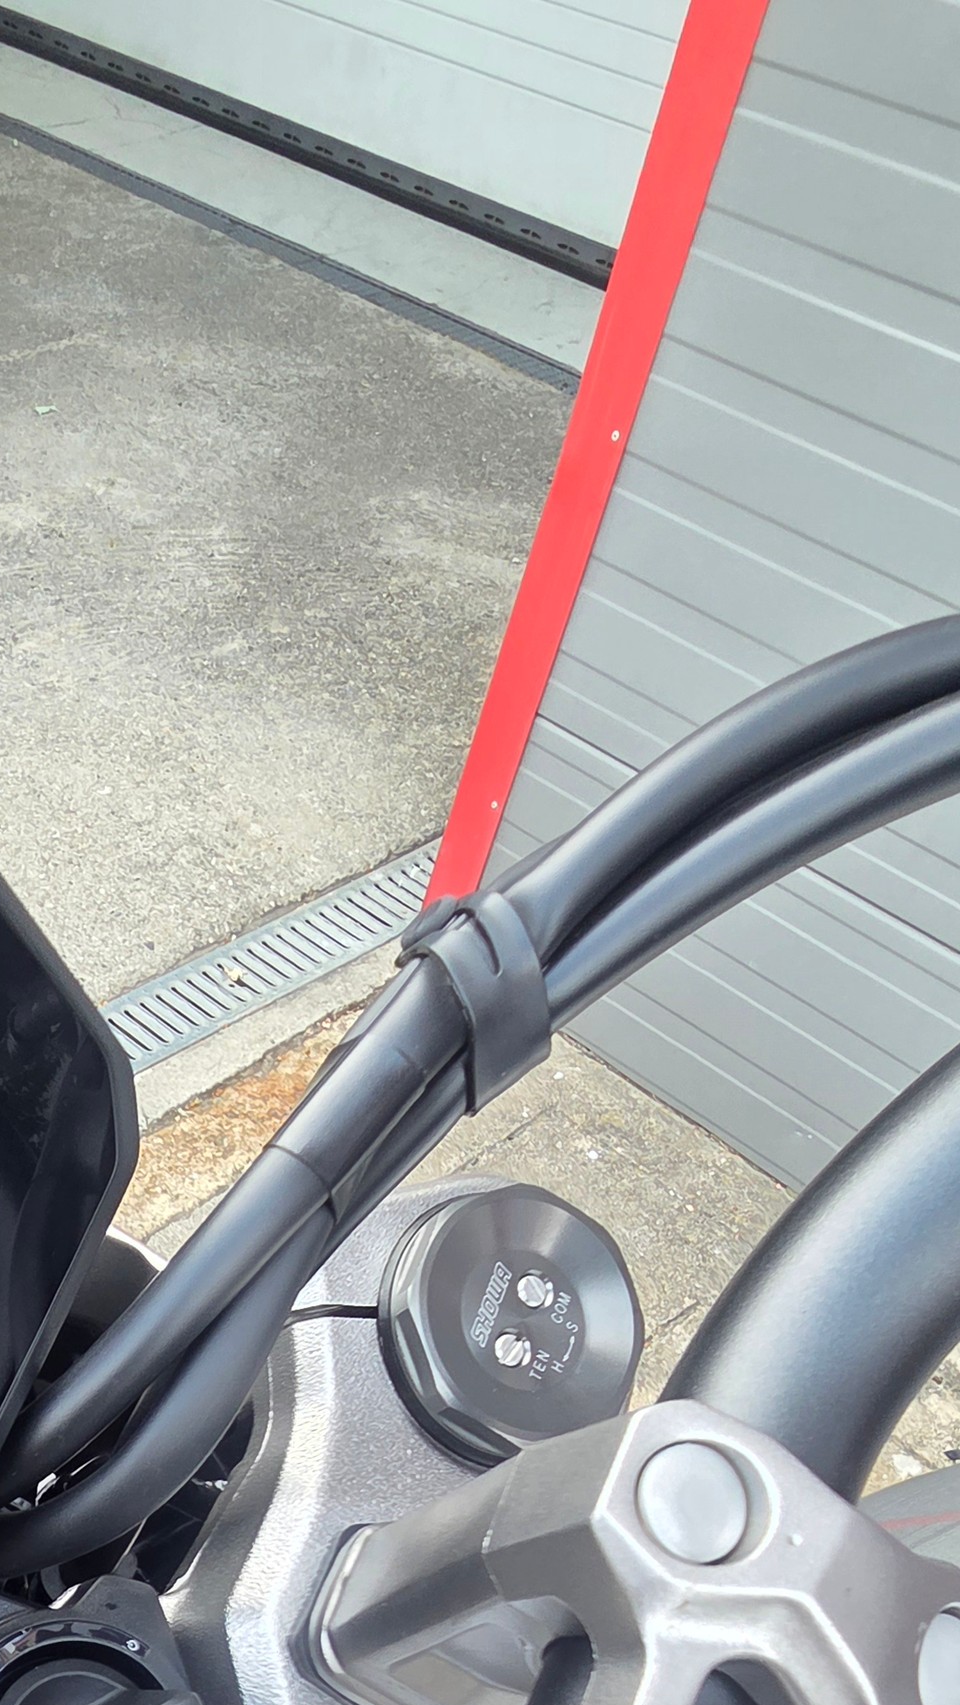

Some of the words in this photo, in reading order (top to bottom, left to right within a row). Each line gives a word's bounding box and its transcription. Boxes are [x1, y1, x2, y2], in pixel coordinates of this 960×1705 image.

[470, 1261, 512, 1348] SHOWA
[529, 1350, 550, 1380] TEN
[550, 1292, 572, 1324] COM
[551, 1361, 565, 1374] H
[566, 1321, 579, 1333] S
